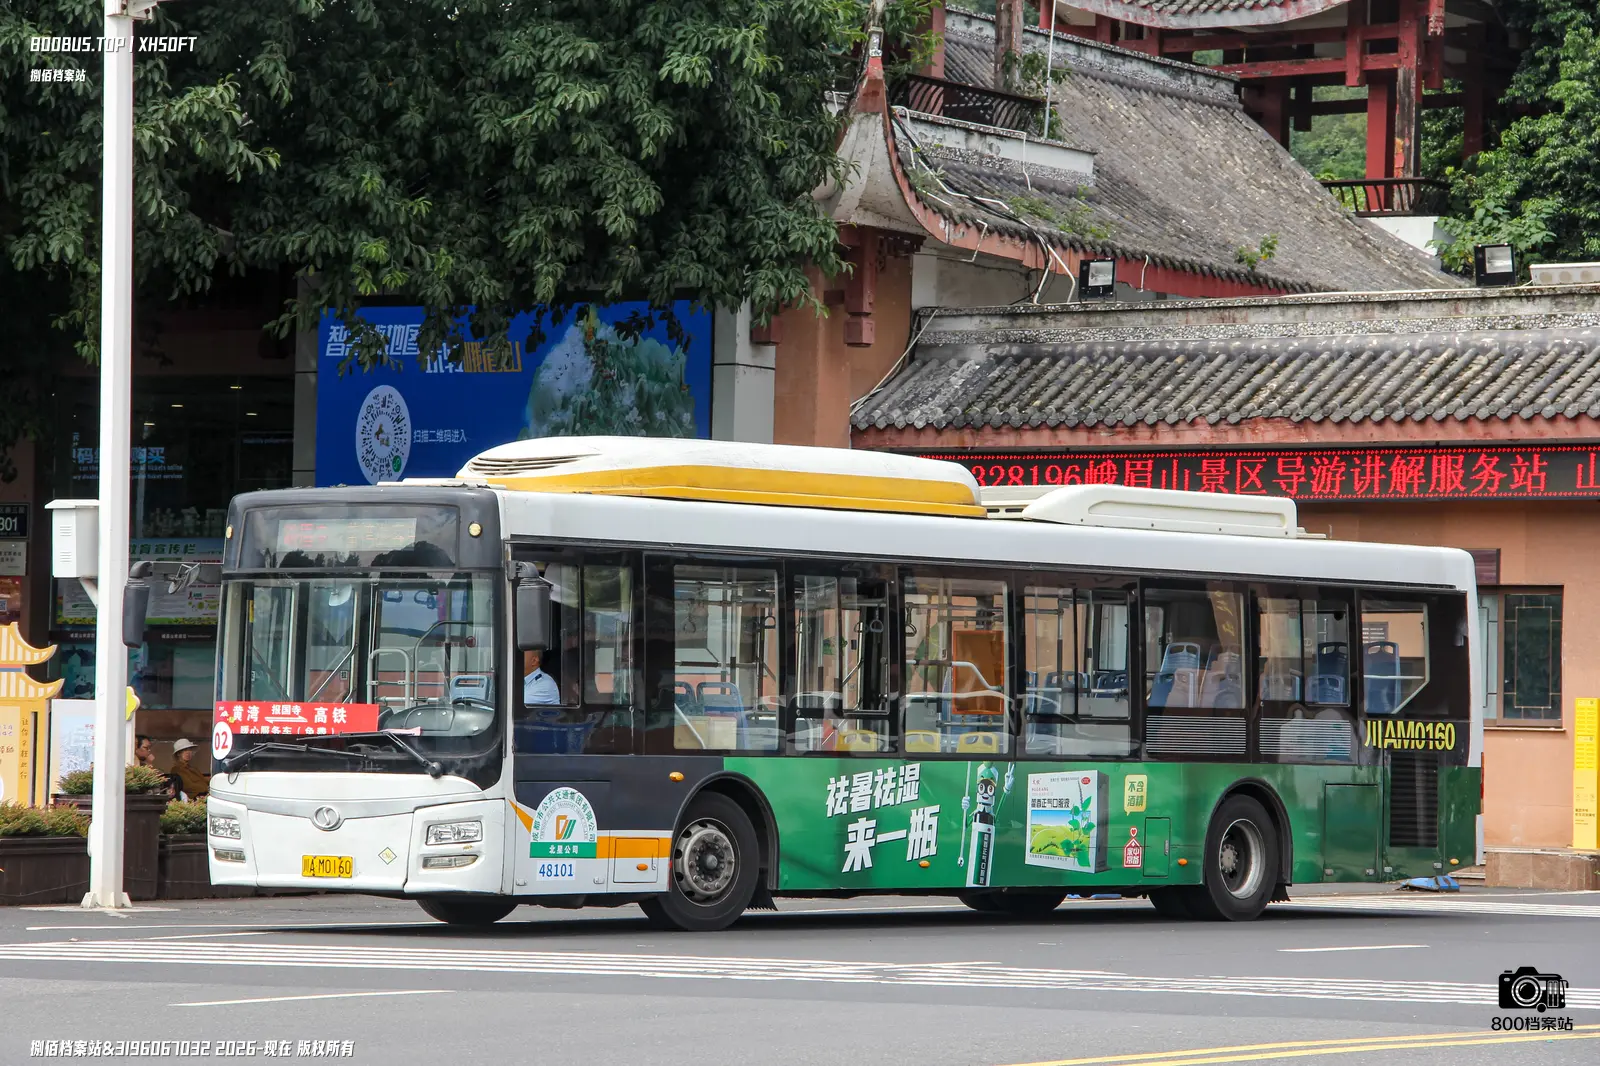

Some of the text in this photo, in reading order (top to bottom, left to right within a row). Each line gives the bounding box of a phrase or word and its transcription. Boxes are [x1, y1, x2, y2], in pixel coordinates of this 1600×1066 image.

[325, 323, 422, 357] 智地图
[413, 429, 467, 443] 扫描二维码进入
[232, 704, 347, 724] 黄湾 报国寺 高铁
[214, 731, 229, 750] 02
[1364, 720, 1456, 750] 川AM0160
[825, 763, 921, 818] 祛暑祛湿
[1127, 780, 1145, 793] 不含
[841, 804, 941, 873] 来一瓶
[538, 863, 574, 877] 48101
